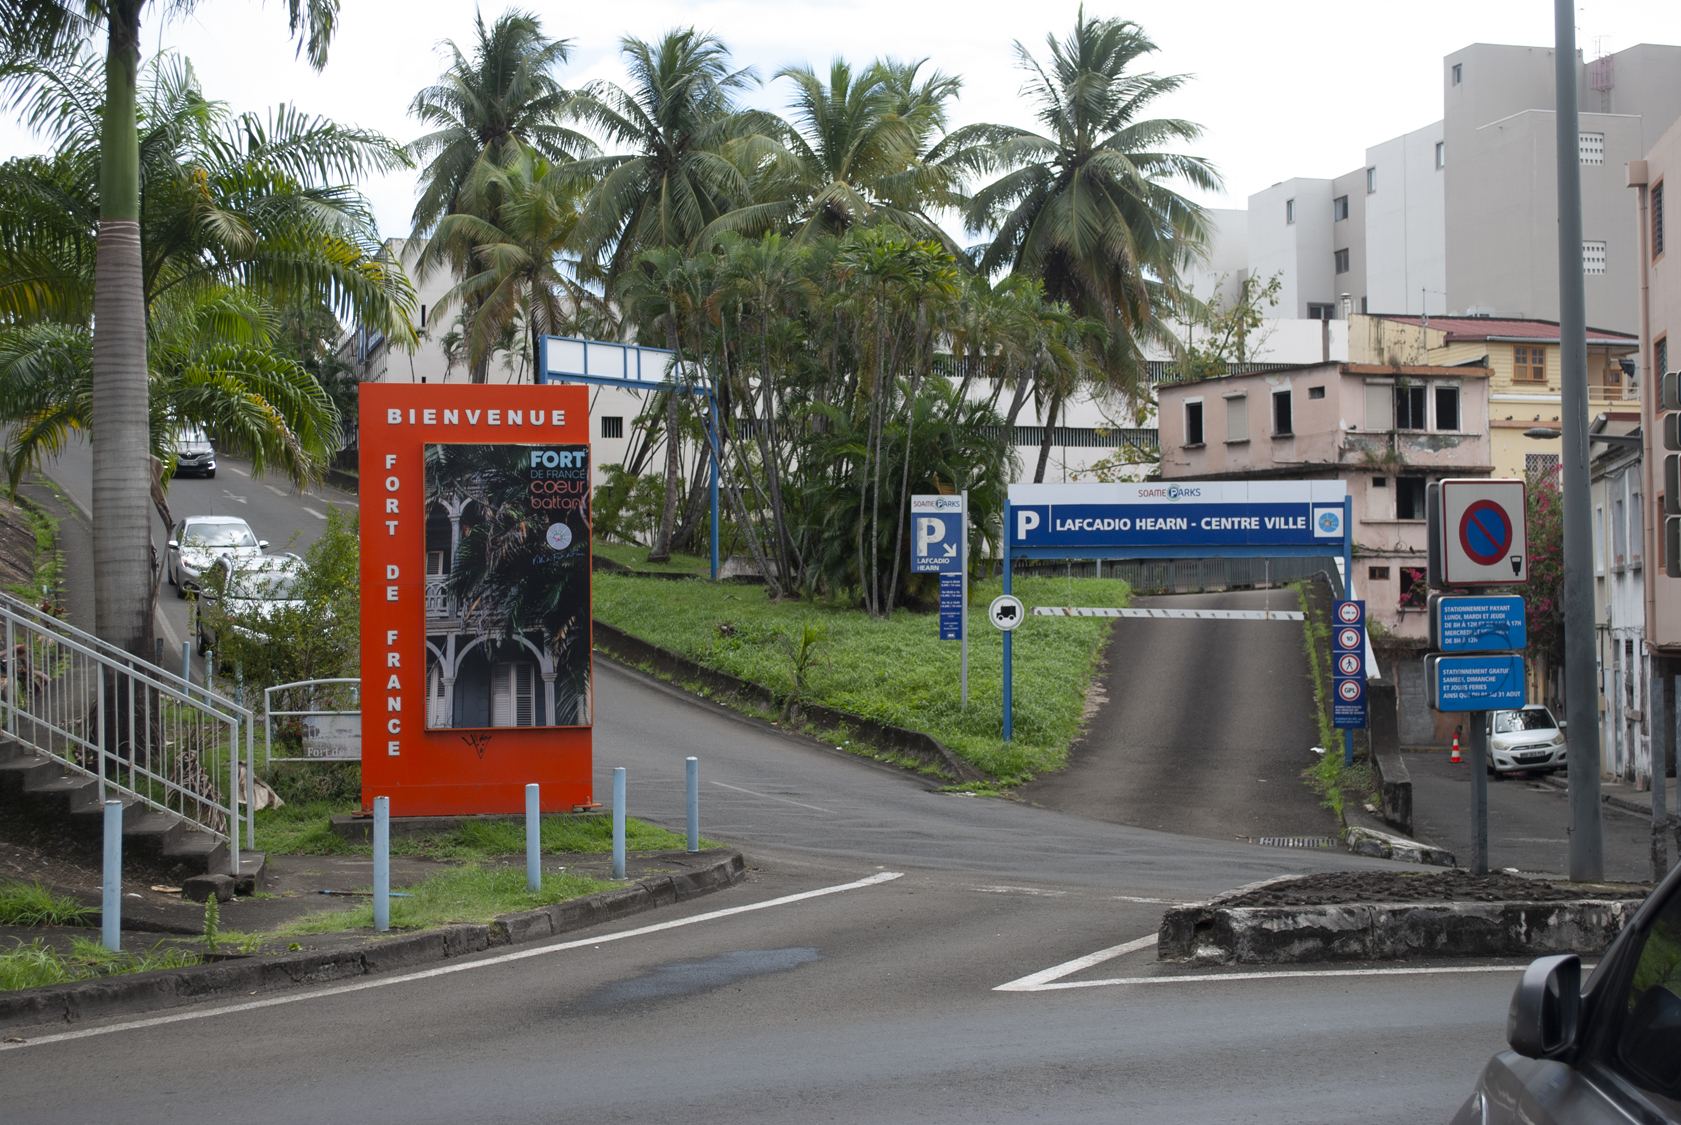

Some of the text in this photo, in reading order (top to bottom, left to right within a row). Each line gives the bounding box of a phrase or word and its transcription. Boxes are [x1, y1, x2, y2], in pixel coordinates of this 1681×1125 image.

[388, 409, 565, 426] BIENVENUE
[531, 451, 585, 468] FORT
[531, 470, 585, 479] DE FRANCE
[531, 495, 585, 509] battant
[1017, 510, 1040, 540] P
[1056, 518, 1131, 531] LAFCADIO
[1136, 518, 1187, 530] HEARN
[1201, 517, 1260, 530] CENTRE
[1264, 516, 1306, 529] VILLE
[917, 517, 946, 557] P
[385, 455, 401, 756] FORT DE FRANCE
[1461, 620, 1466, 628] À
[307, 747, 330, 757] Fort
